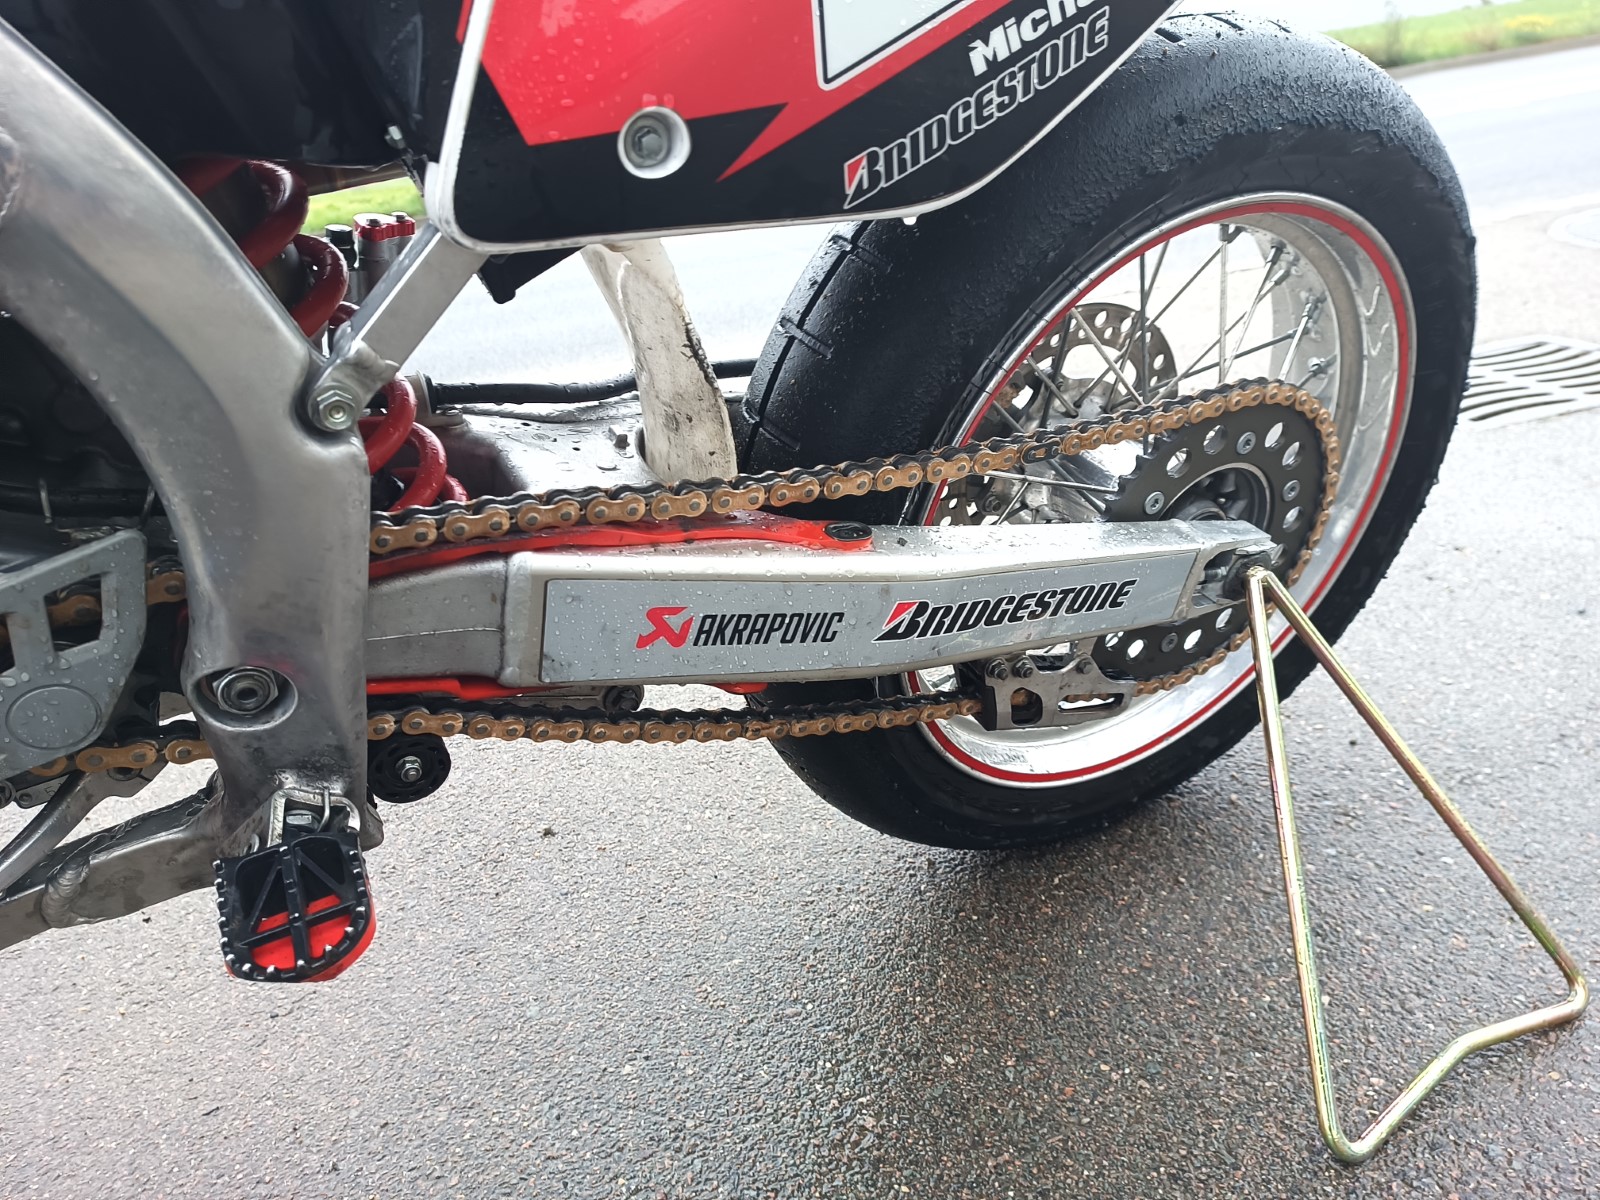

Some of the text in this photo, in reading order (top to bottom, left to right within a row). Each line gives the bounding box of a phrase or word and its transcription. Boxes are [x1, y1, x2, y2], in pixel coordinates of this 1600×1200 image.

[968, 0, 1097, 77] Mich
[843, 5, 1110, 209] BRIDGESTONE
[693, 612, 845, 647] AKRAPOVIC
[871, 578, 1139, 643] BRIDGESTONE
